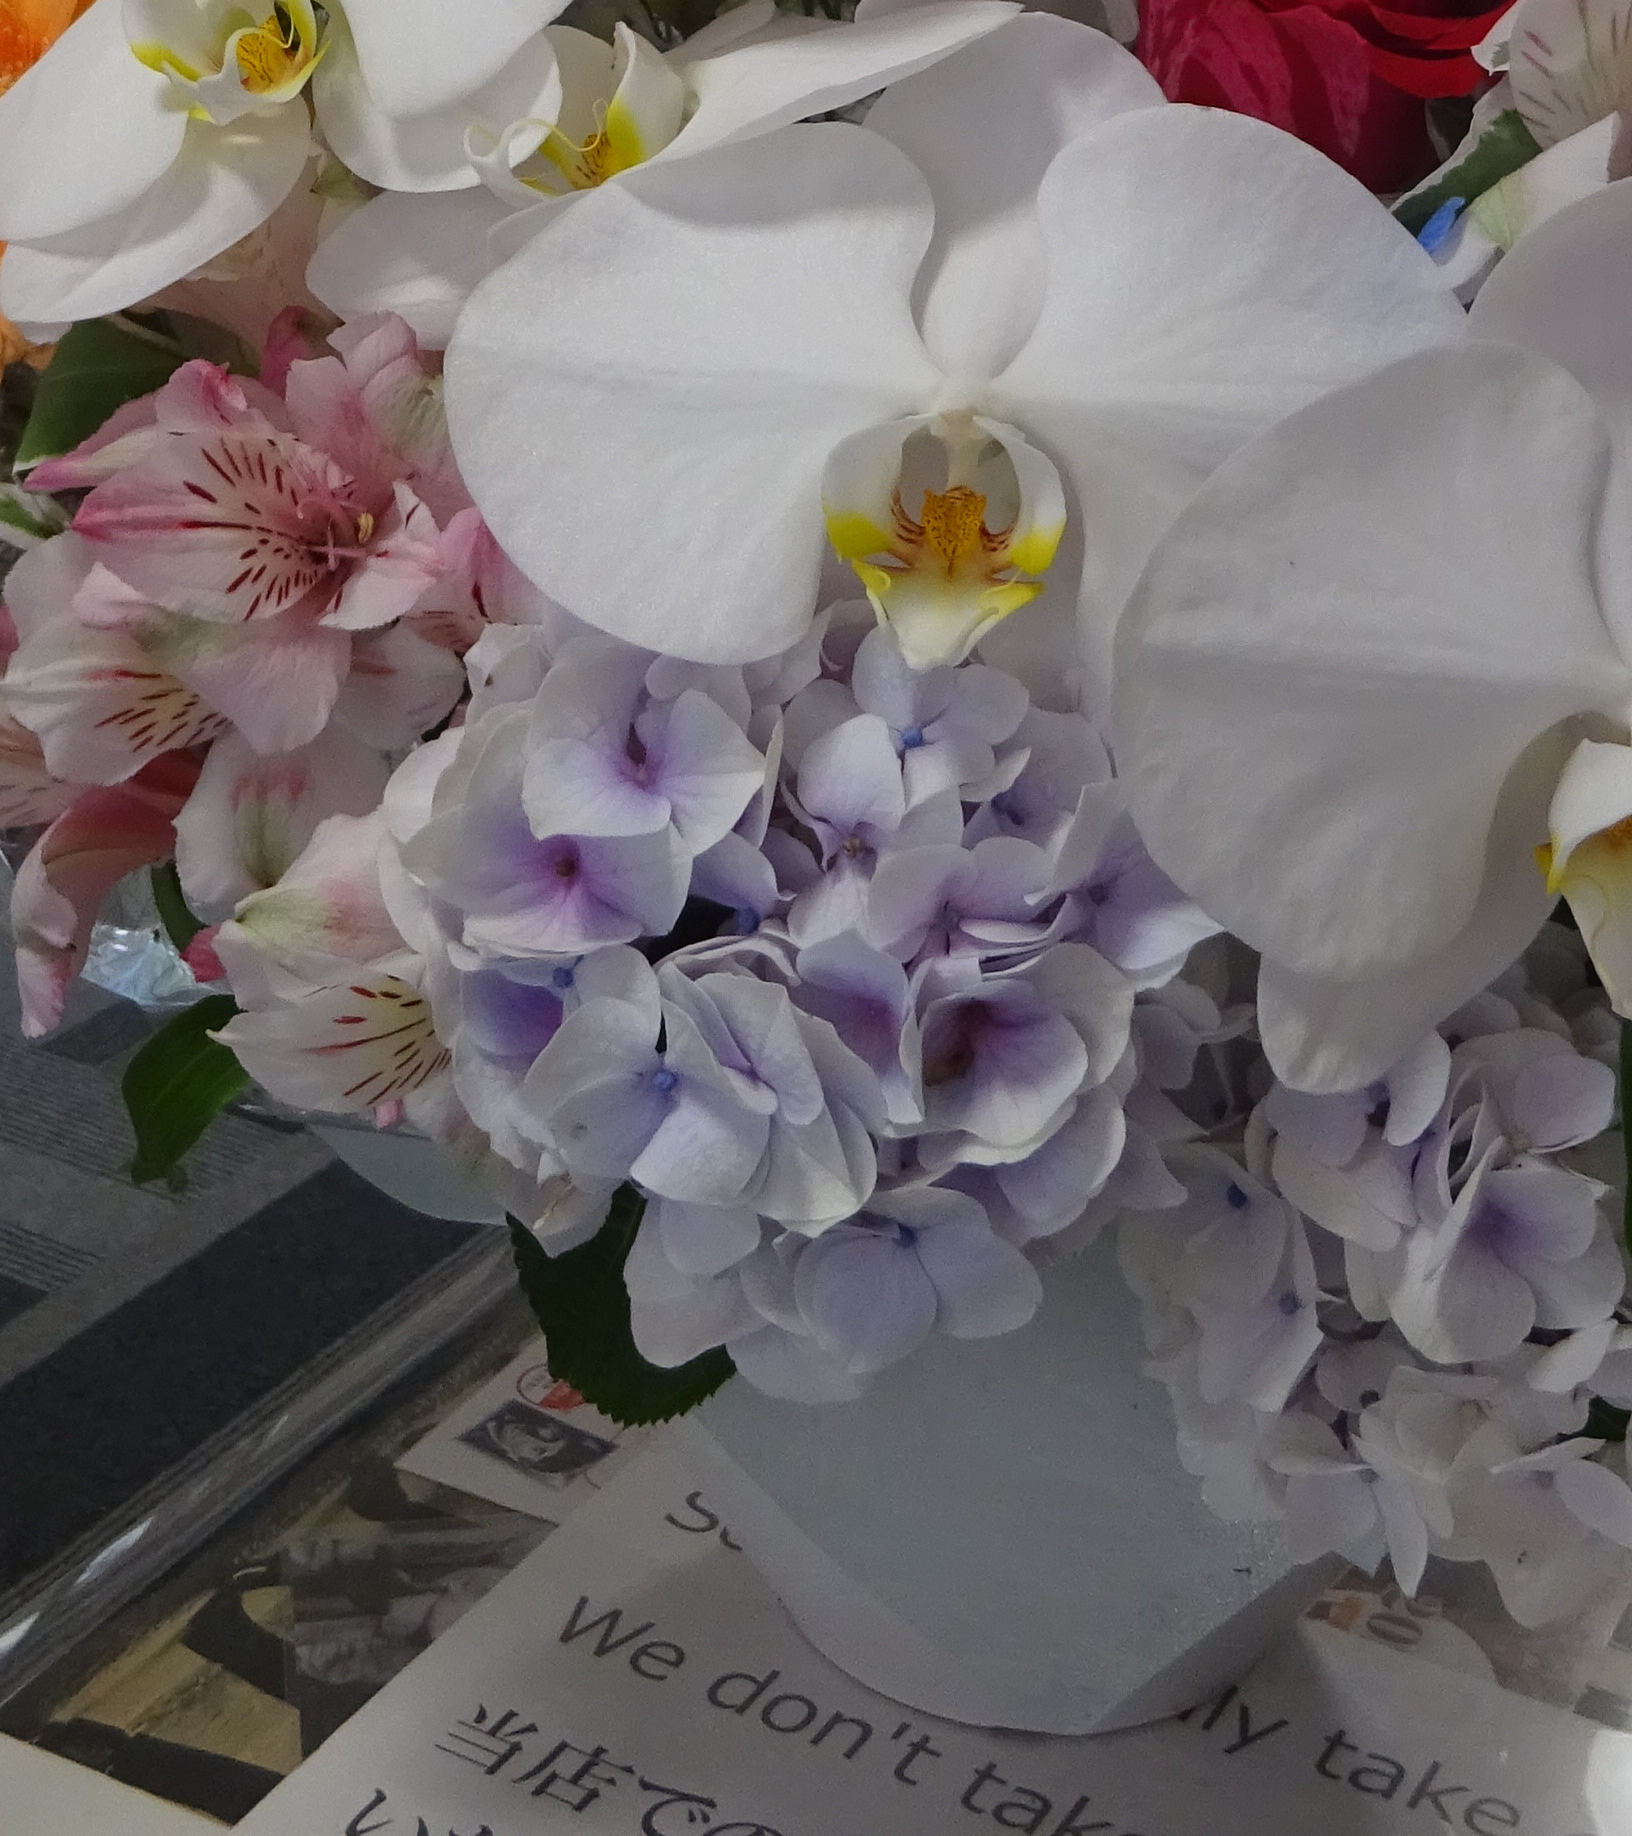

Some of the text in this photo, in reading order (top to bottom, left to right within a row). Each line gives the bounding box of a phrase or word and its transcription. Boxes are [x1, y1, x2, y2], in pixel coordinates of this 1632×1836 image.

[433, 1703, 790, 1836] 当店で
[559, 1594, 1144, 1836] We don't tak
[1313, 1728, 1523, 1836] take
